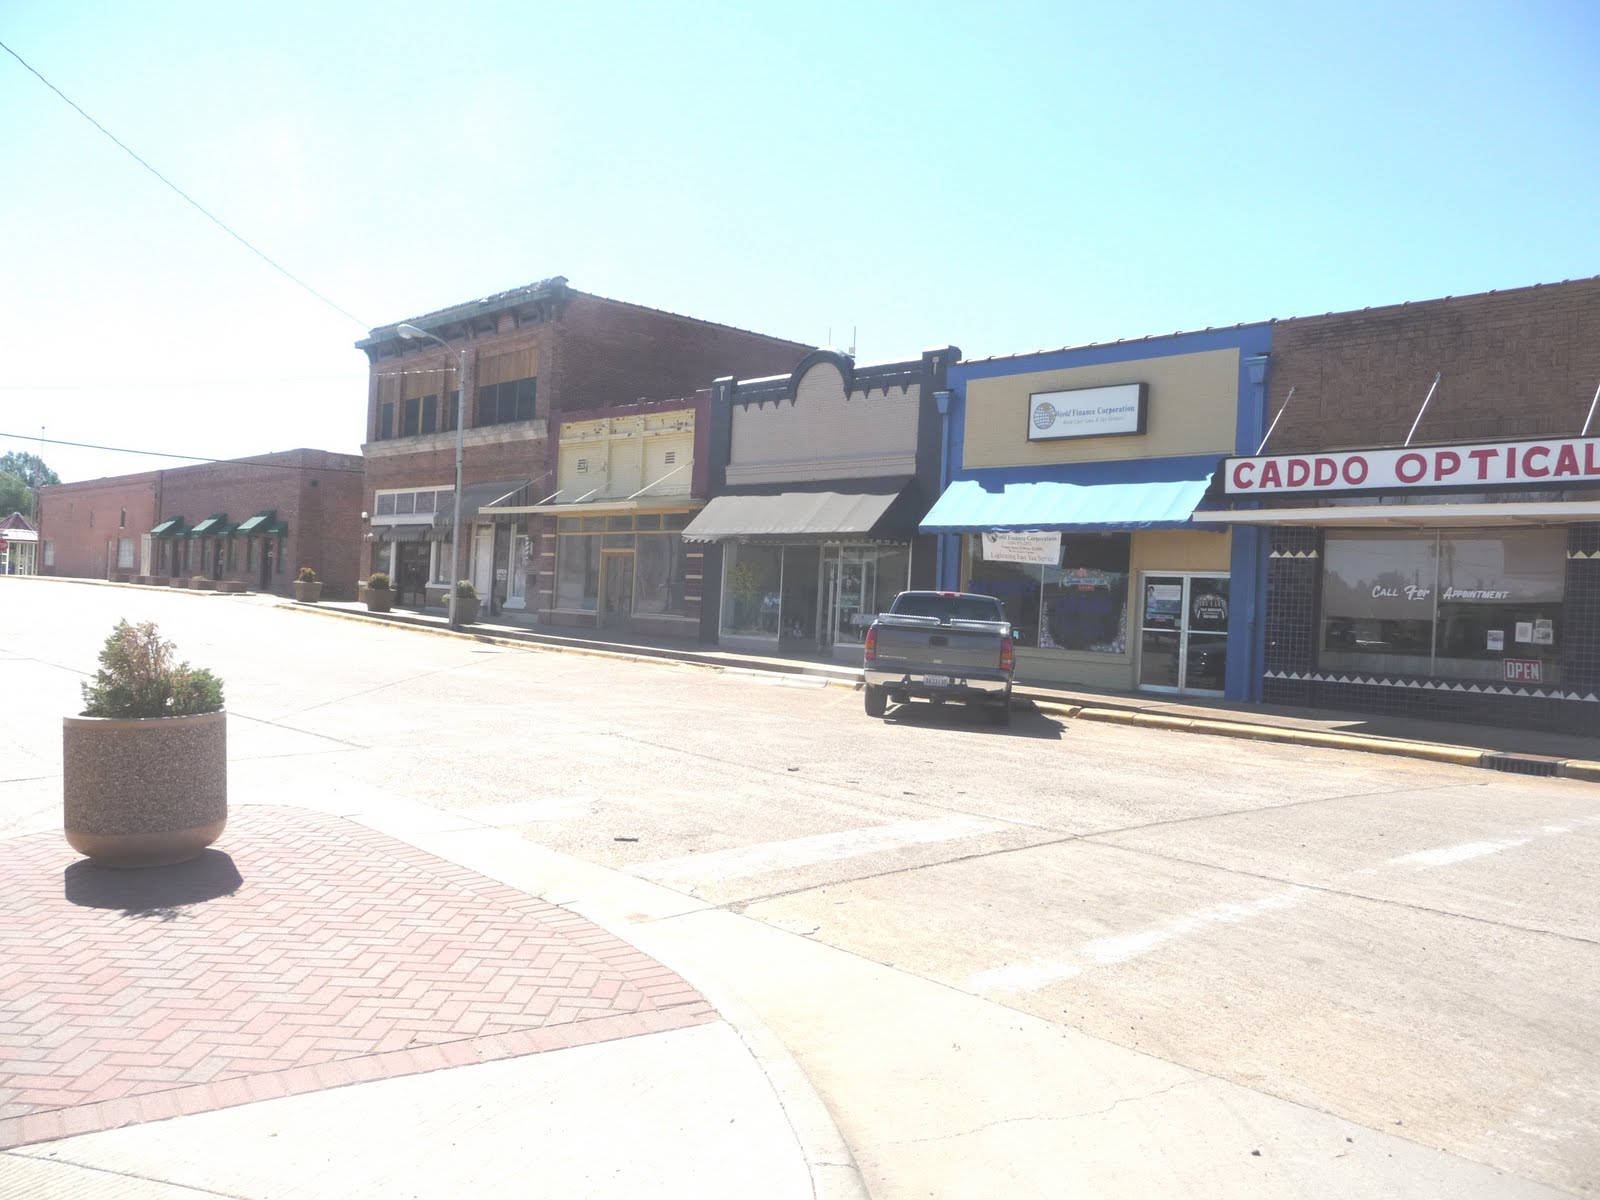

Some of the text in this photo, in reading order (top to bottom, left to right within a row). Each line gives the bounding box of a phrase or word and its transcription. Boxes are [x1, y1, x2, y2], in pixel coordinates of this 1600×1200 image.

[1055, 405, 1135, 418] World Finance Corporation
[1232, 443, 1600, 489] CADDO OPTICAL
[1027, 535, 1057, 543] Corporation
[1506, 662, 1540, 680] OPEN
